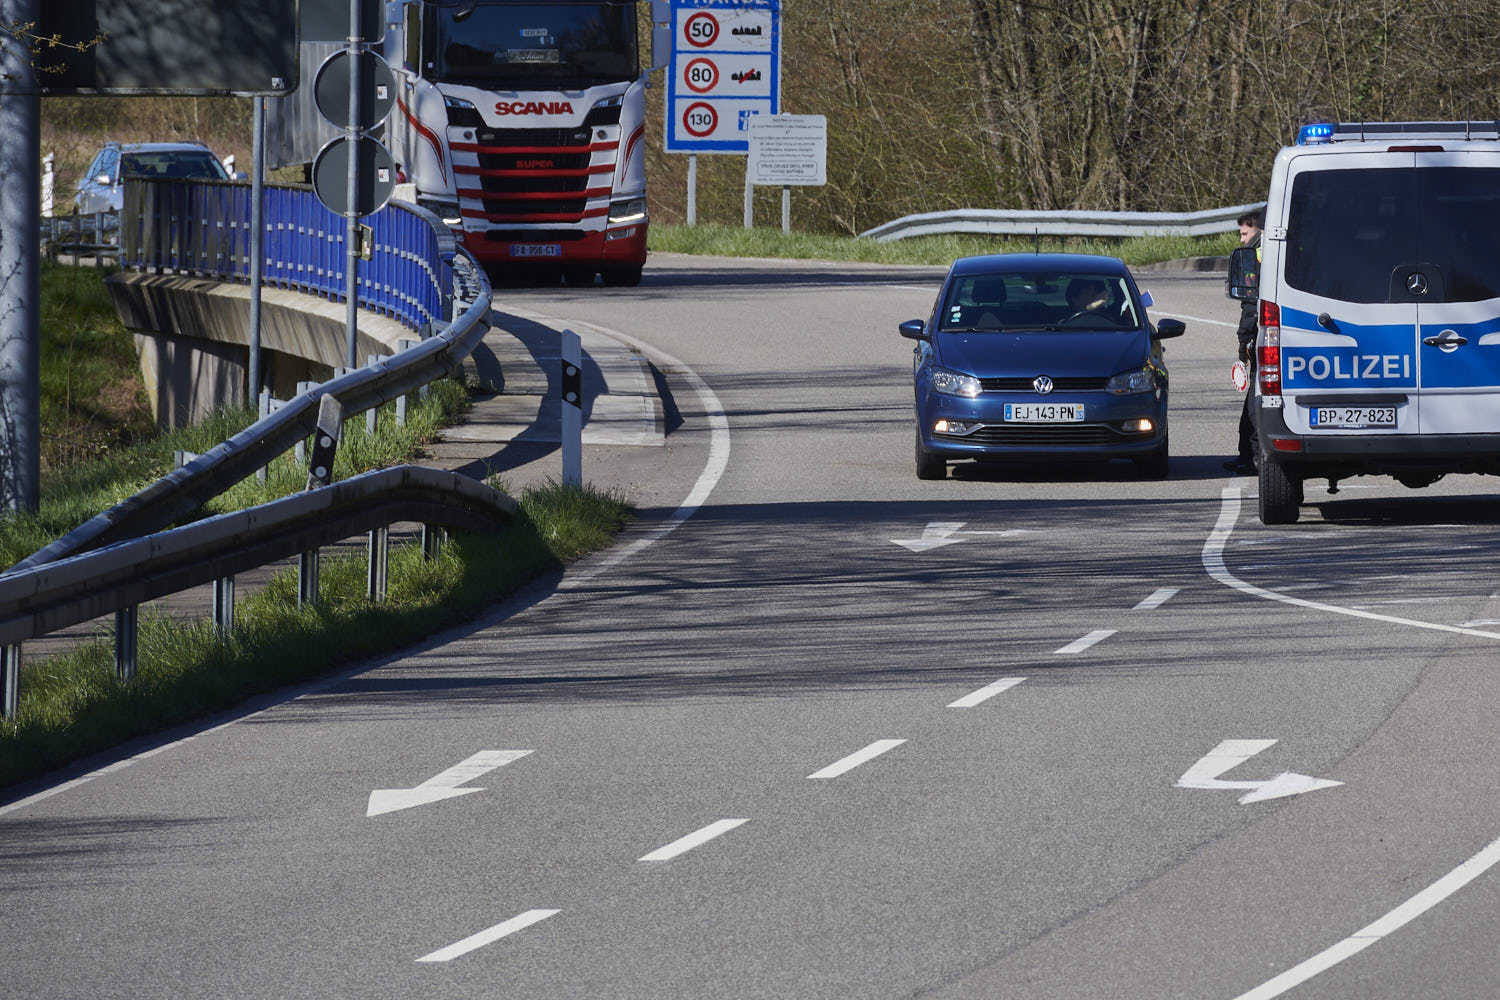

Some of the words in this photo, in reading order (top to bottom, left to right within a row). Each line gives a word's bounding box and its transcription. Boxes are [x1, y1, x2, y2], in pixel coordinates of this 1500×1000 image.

[691, 22, 714, 38] 50
[691, 67, 712, 83] 80
[494, 101, 574, 116] SCANIA
[689, 113, 712, 126] 130
[516, 160, 554, 169] SUPER
[1287, 354, 1410, 381] POLIZEI
[1319, 409, 1337, 423] BP
[1345, 409, 1394, 423] 27-823
